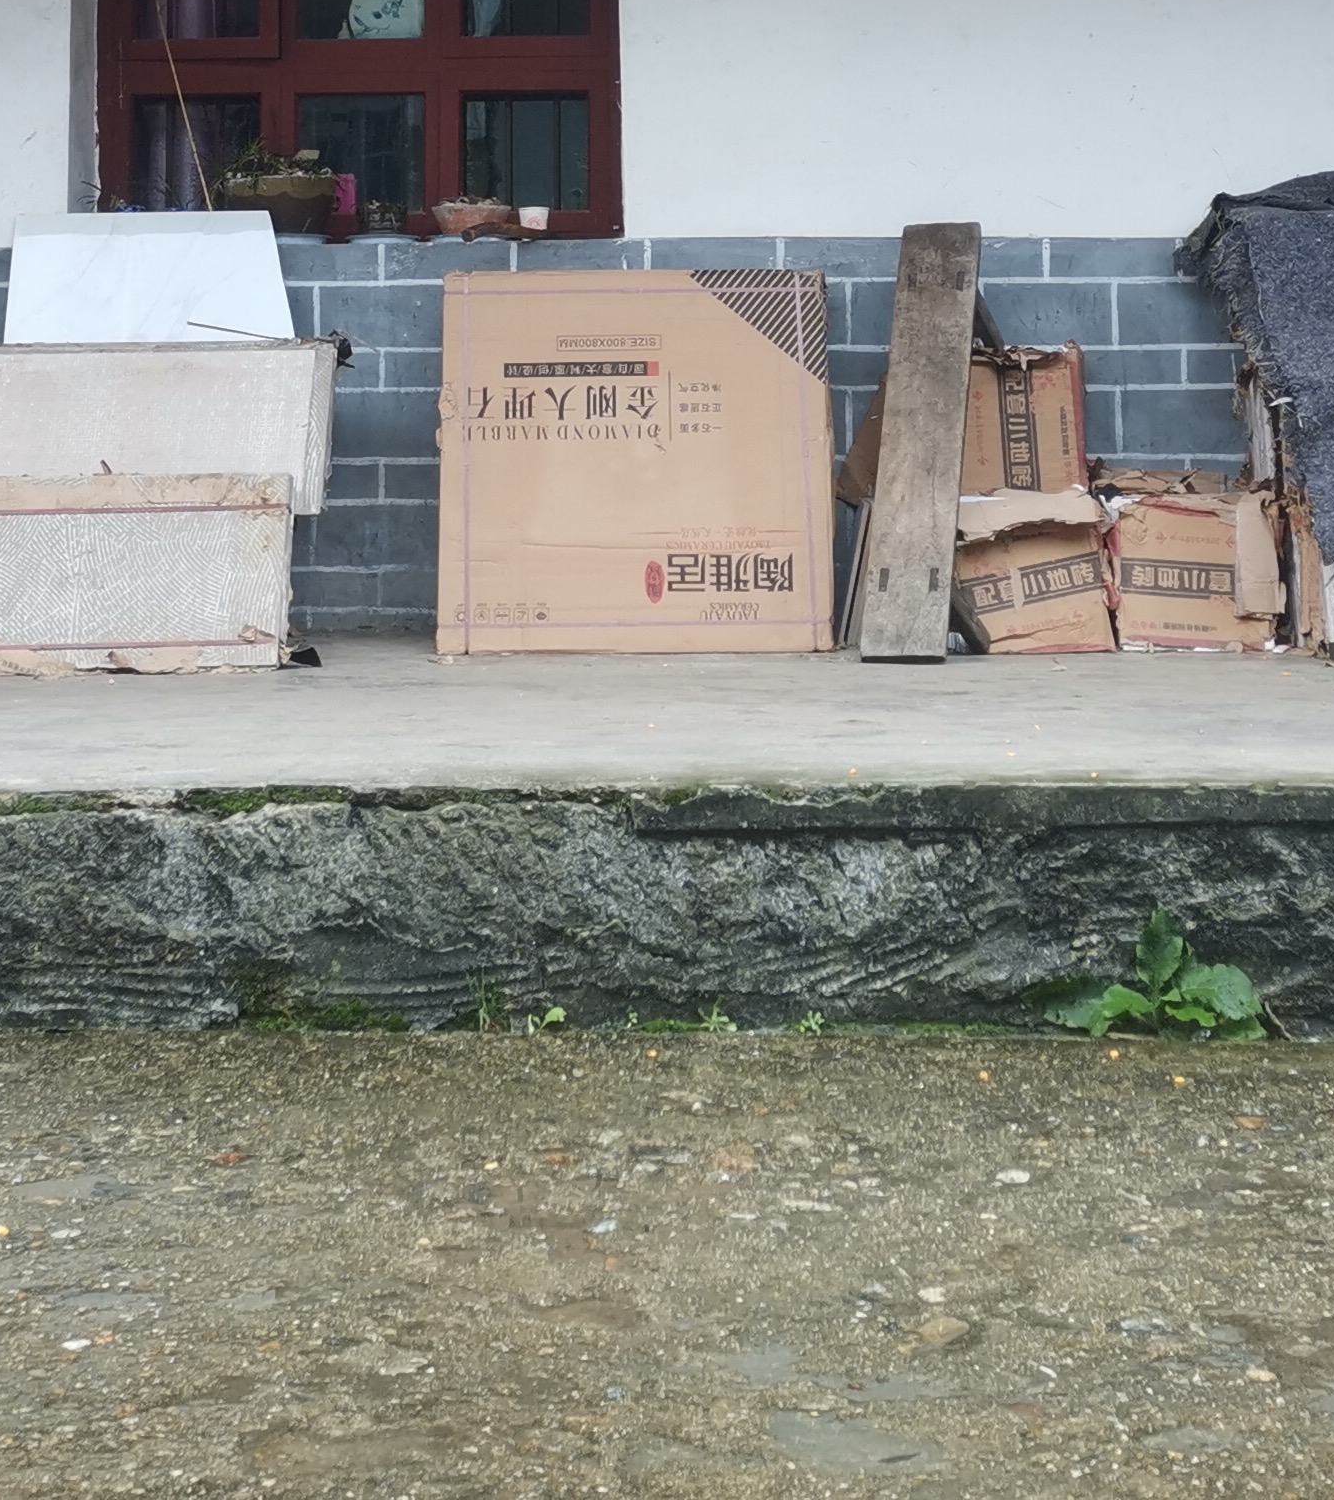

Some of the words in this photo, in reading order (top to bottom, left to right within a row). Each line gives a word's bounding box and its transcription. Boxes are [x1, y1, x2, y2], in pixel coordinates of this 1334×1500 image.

[464, 384, 660, 421] 金刚大理石
[667, 551, 794, 593] 陶雅居
